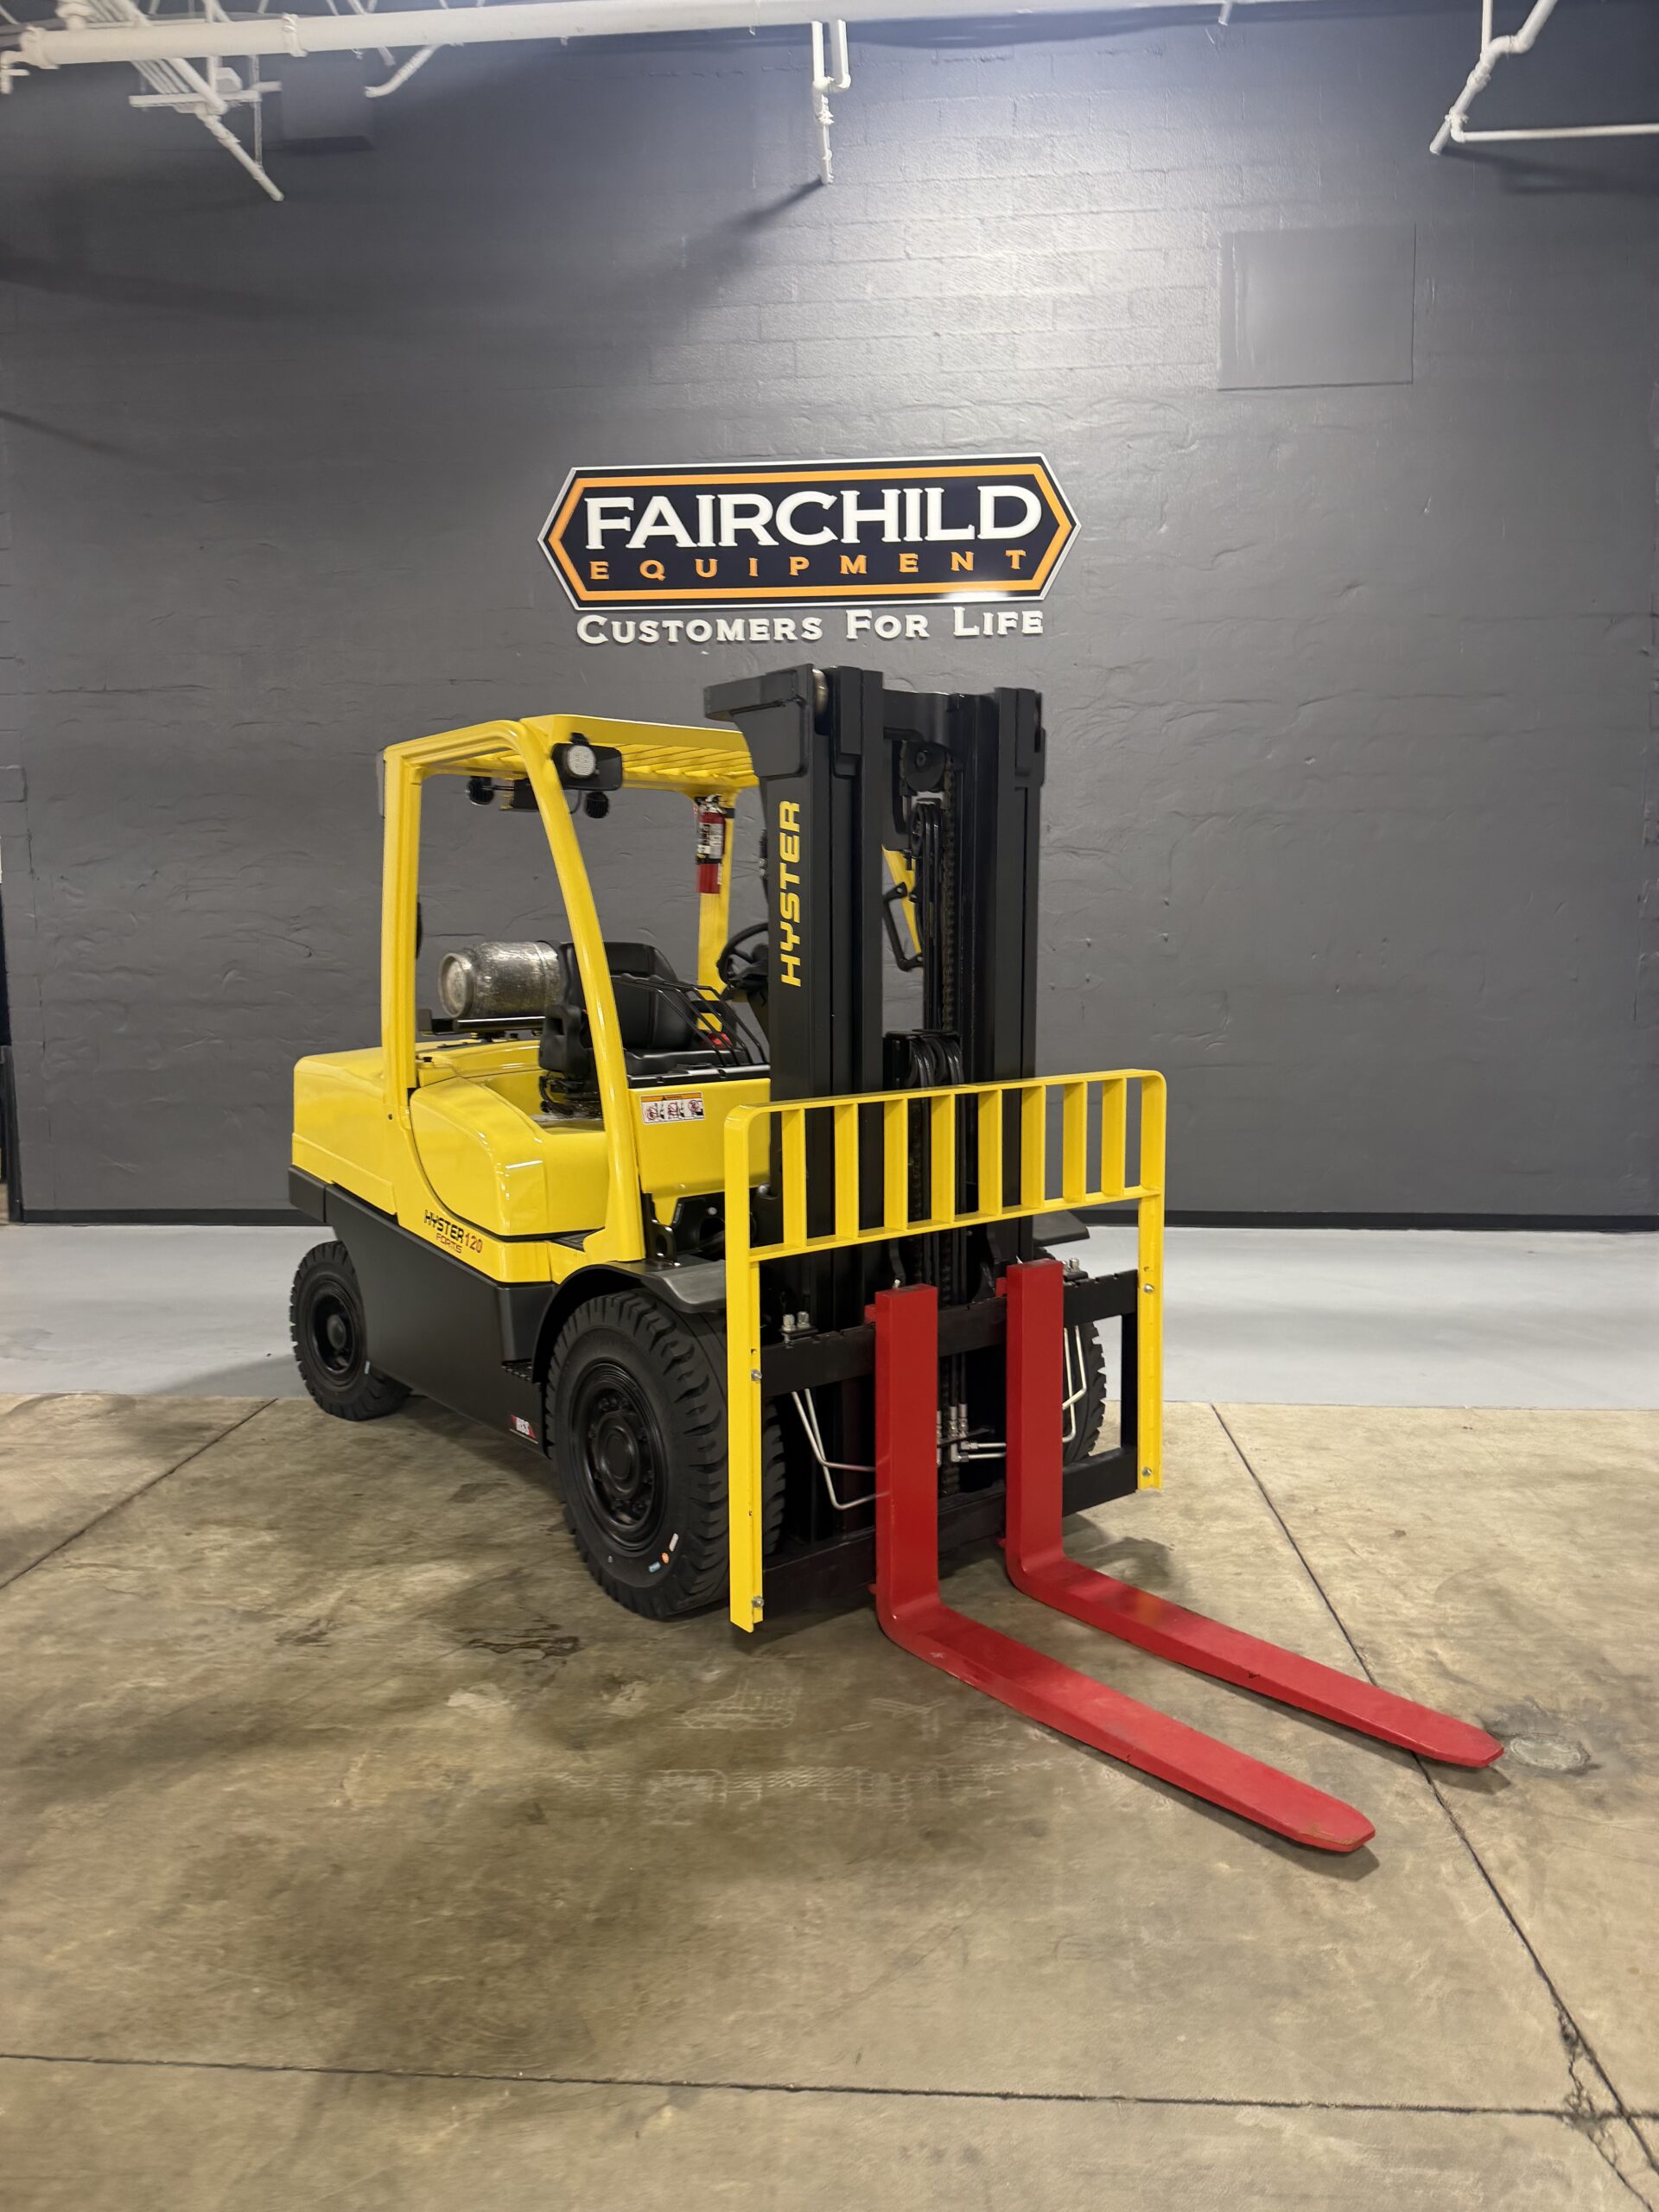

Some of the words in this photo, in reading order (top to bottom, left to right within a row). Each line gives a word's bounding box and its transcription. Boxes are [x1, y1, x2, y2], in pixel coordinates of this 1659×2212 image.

[584, 485, 1043, 550] FAIRCHILD
[589, 549, 1027, 582] EQUIPMENT
[576, 613, 824, 645] CUSTOMERS
[846, 608, 930, 640] FOR
[952, 606, 1044, 638] LIFE
[779, 800, 802, 988] HYSTER
[424, 1209, 464, 1243] HYSTER
[465, 1233, 483, 1254] 120
